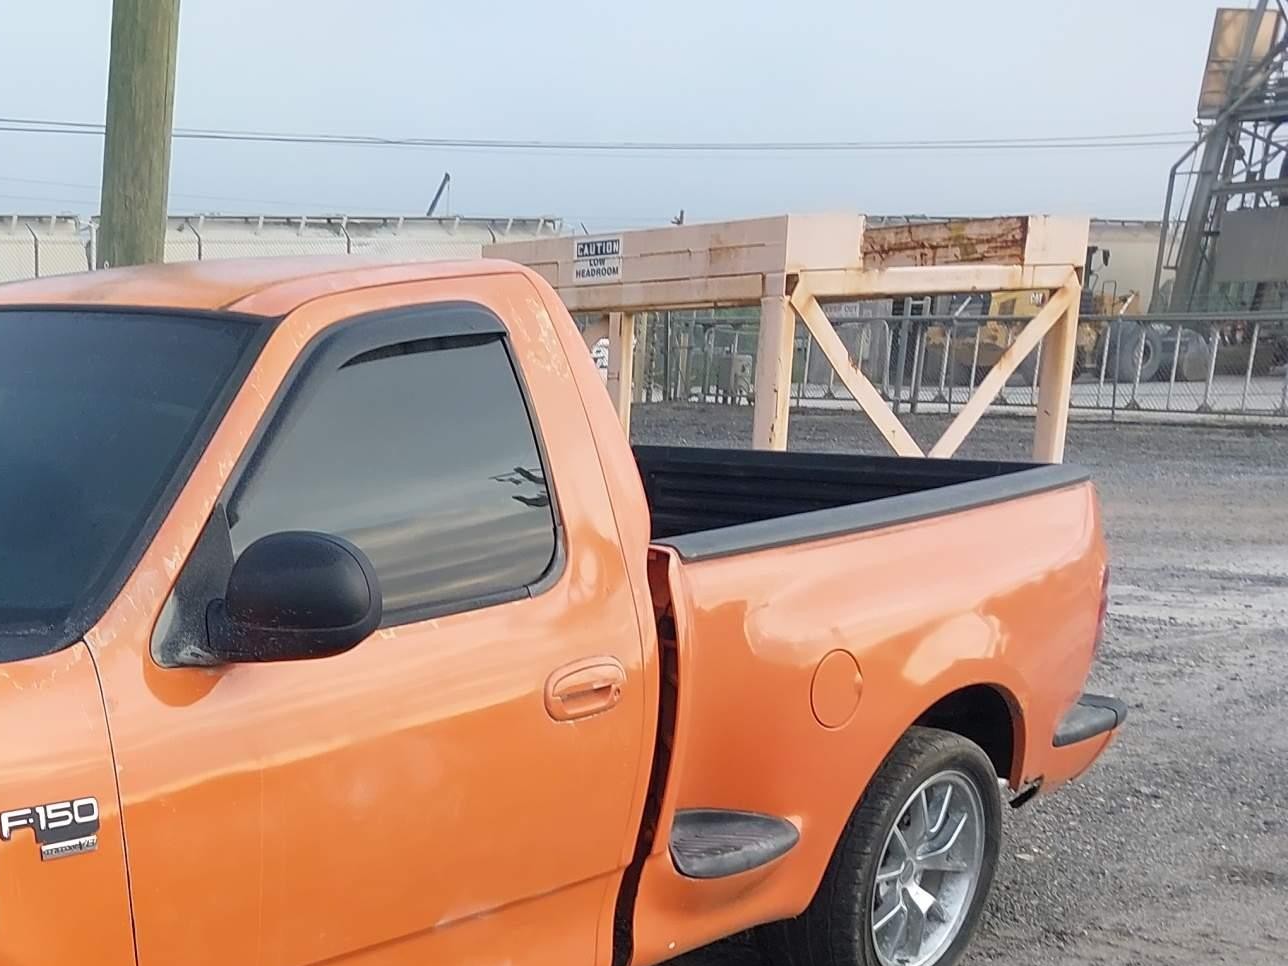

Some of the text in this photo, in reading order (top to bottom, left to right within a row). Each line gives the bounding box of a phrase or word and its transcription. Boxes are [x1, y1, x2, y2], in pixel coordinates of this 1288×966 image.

[577, 240, 619, 256] CAUTION
[589, 257, 606, 267] LOW
[575, 266, 619, 279] HEADROOM
